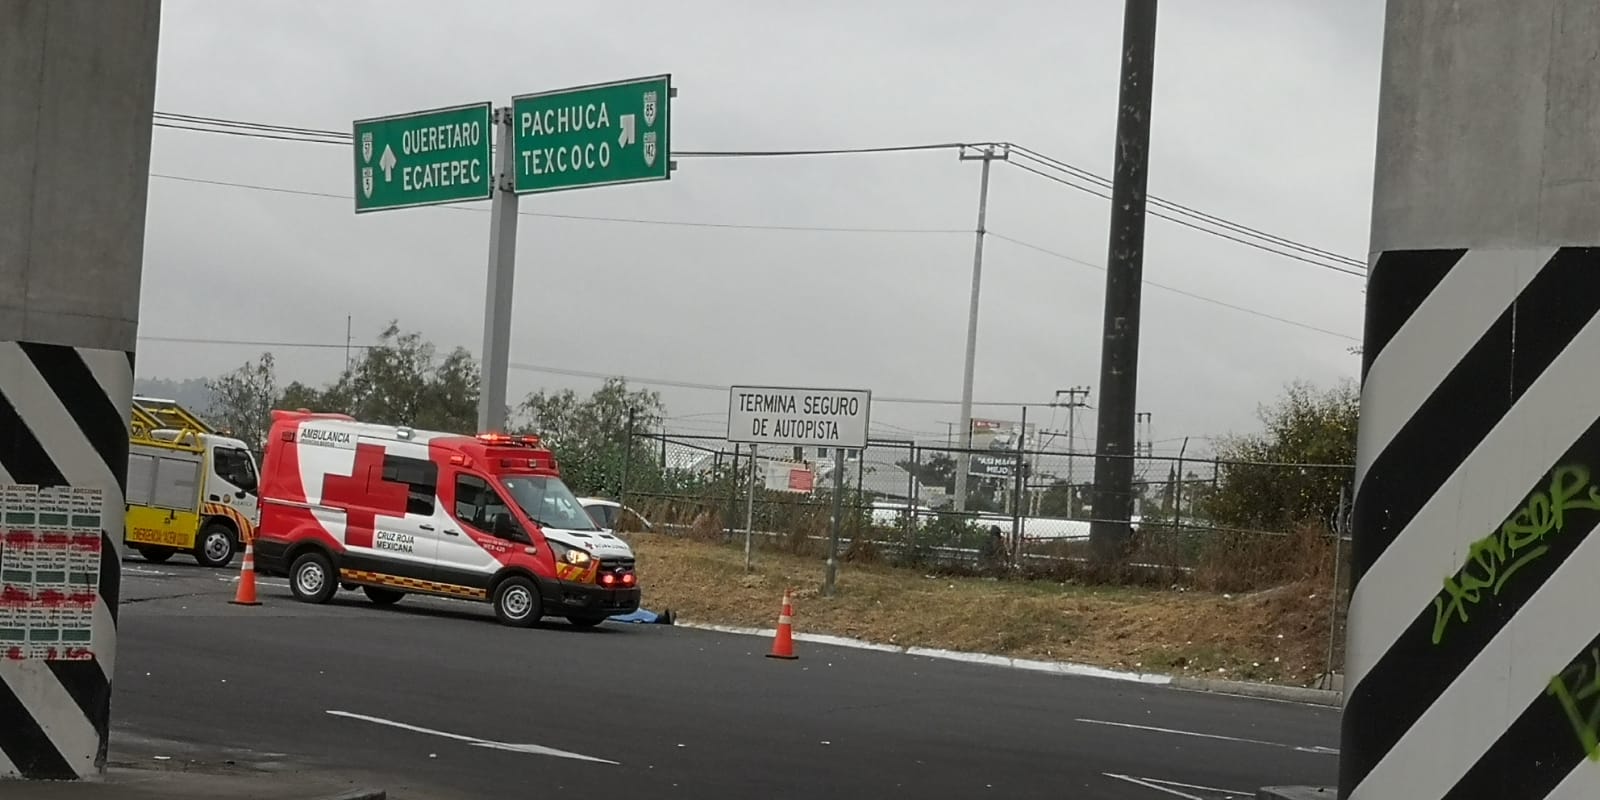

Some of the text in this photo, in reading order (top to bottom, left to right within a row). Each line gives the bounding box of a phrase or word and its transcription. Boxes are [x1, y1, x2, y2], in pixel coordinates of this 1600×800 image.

[521, 102, 610, 138] PACHUCA
[402, 121, 480, 155] QUERETARO
[522, 141, 610, 176] TEXCOCO
[403, 158, 480, 191] ECATEPEC
[739, 394, 859, 416] TERMINA SEGURO
[301, 428, 351, 443] AMBULANCIA
[752, 418, 839, 440] DE AUTOPISTA
[376, 540, 413, 554] MEXICANA
[377, 531, 414, 545] CRUZ ROJA
